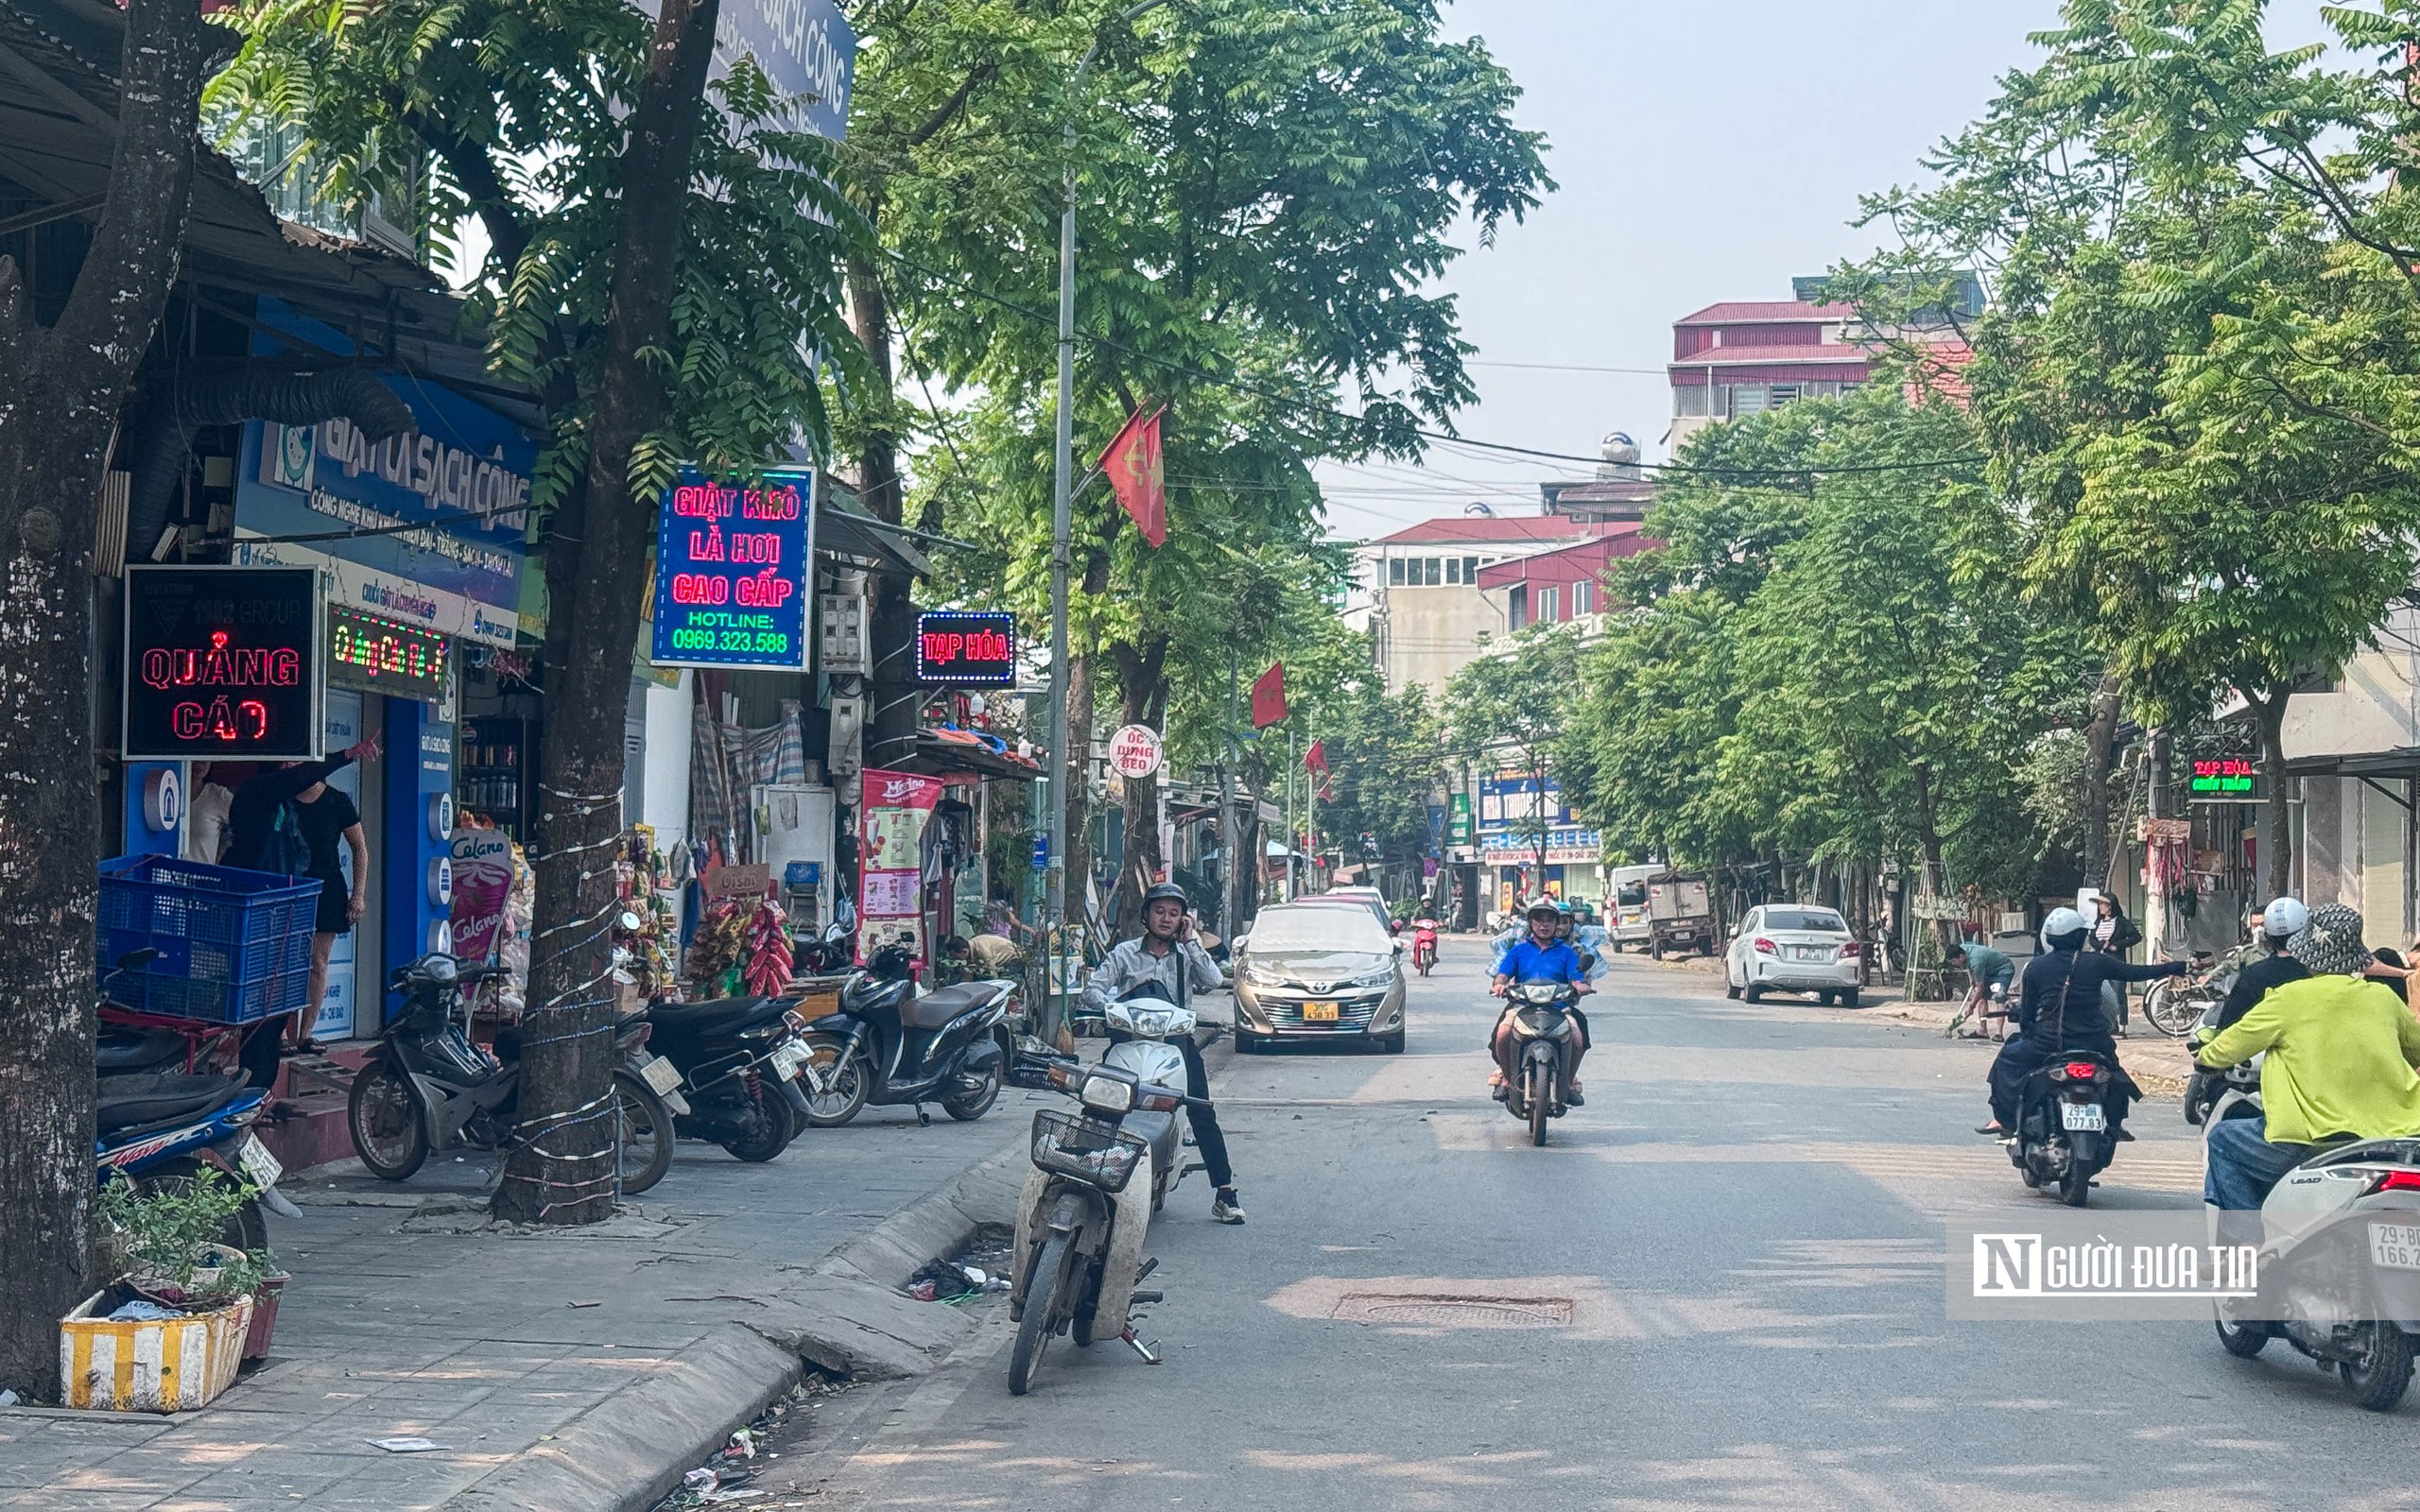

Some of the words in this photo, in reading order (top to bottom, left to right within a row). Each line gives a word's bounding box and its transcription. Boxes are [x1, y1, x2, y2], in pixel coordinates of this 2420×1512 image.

[805, 18, 844, 115] CÔNG
[415, 435, 474, 509] SẠCH
[475, 444, 529, 531] CÔNG
[311, 485, 337, 517] CÔNG
[674, 481, 737, 522] GIẶT
[689, 524, 725, 561] LÀ
[731, 533, 781, 563] HƠI
[672, 574, 729, 605] CAO
[735, 567, 793, 607] CẤP
[239, 598, 302, 625] GROUP
[688, 612, 774, 629] HOTLINE:
[672, 628, 788, 653] 0969.323.588
[923, 633, 963, 665] TẠP
[966, 627, 1009, 661] HÓA
[143, 630, 299, 690] QUẢNG
[174, 695, 266, 740] CÁO
[885, 777, 925, 793] Merino
[451, 836, 504, 859] Celano
[721, 871, 756, 888] Oishi
[2066, 1117, 2101, 1129] 077.83
